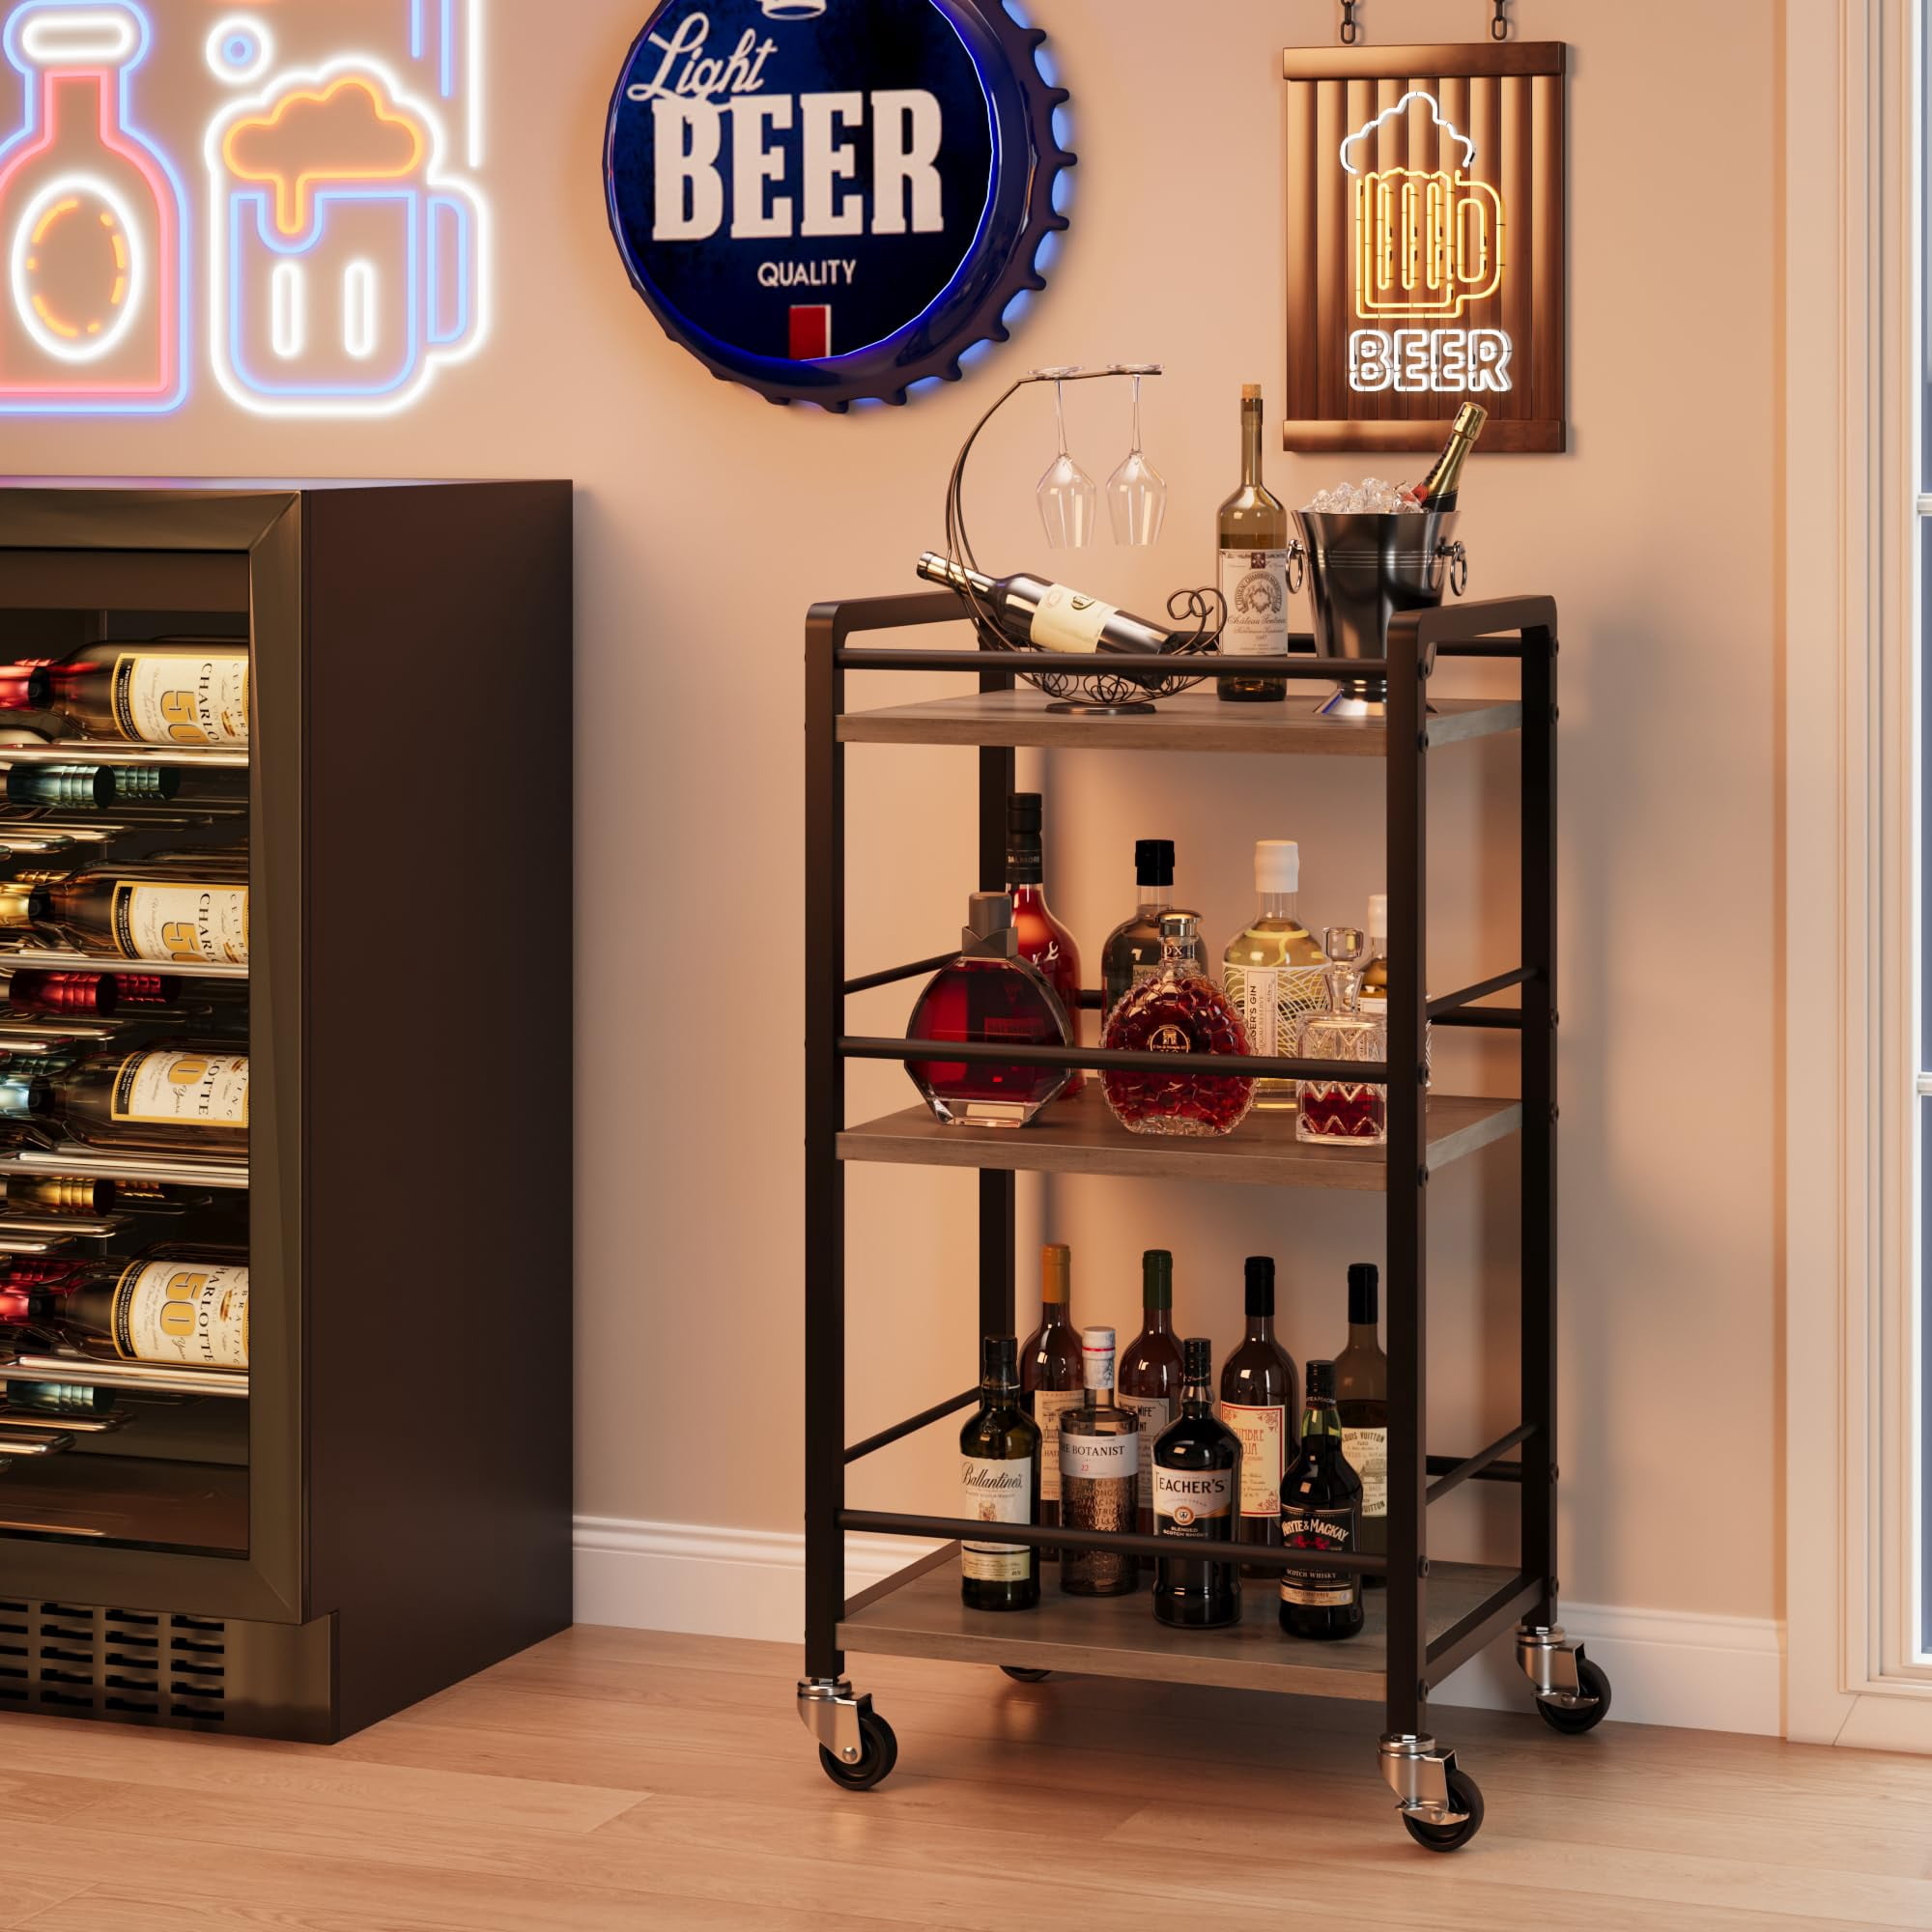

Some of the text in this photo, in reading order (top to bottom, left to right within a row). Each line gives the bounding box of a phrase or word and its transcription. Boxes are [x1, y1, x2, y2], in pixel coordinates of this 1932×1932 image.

[626, 12, 779, 104] Light
[651, 88, 945, 242] BEER
[757, 260, 856, 288] QUALITY
[1349, 328, 1512, 392] BEER
[199, 663, 219, 740] CHARLO
[199, 1060, 226, 1115] LOTTE
[160, 1272, 209, 1337] 50
[198, 1267, 229, 1361] HARLOTTE
[961, 1461, 1023, 1489] Ballantine's
[1072, 1445, 1124, 1457] BOTANIST
[1155, 1471, 1225, 1493] TEACHER'S
[1309, 1518, 1350, 1543] MACKAY
[1286, 1568, 1337, 1579] SCOTCH WHISKY
